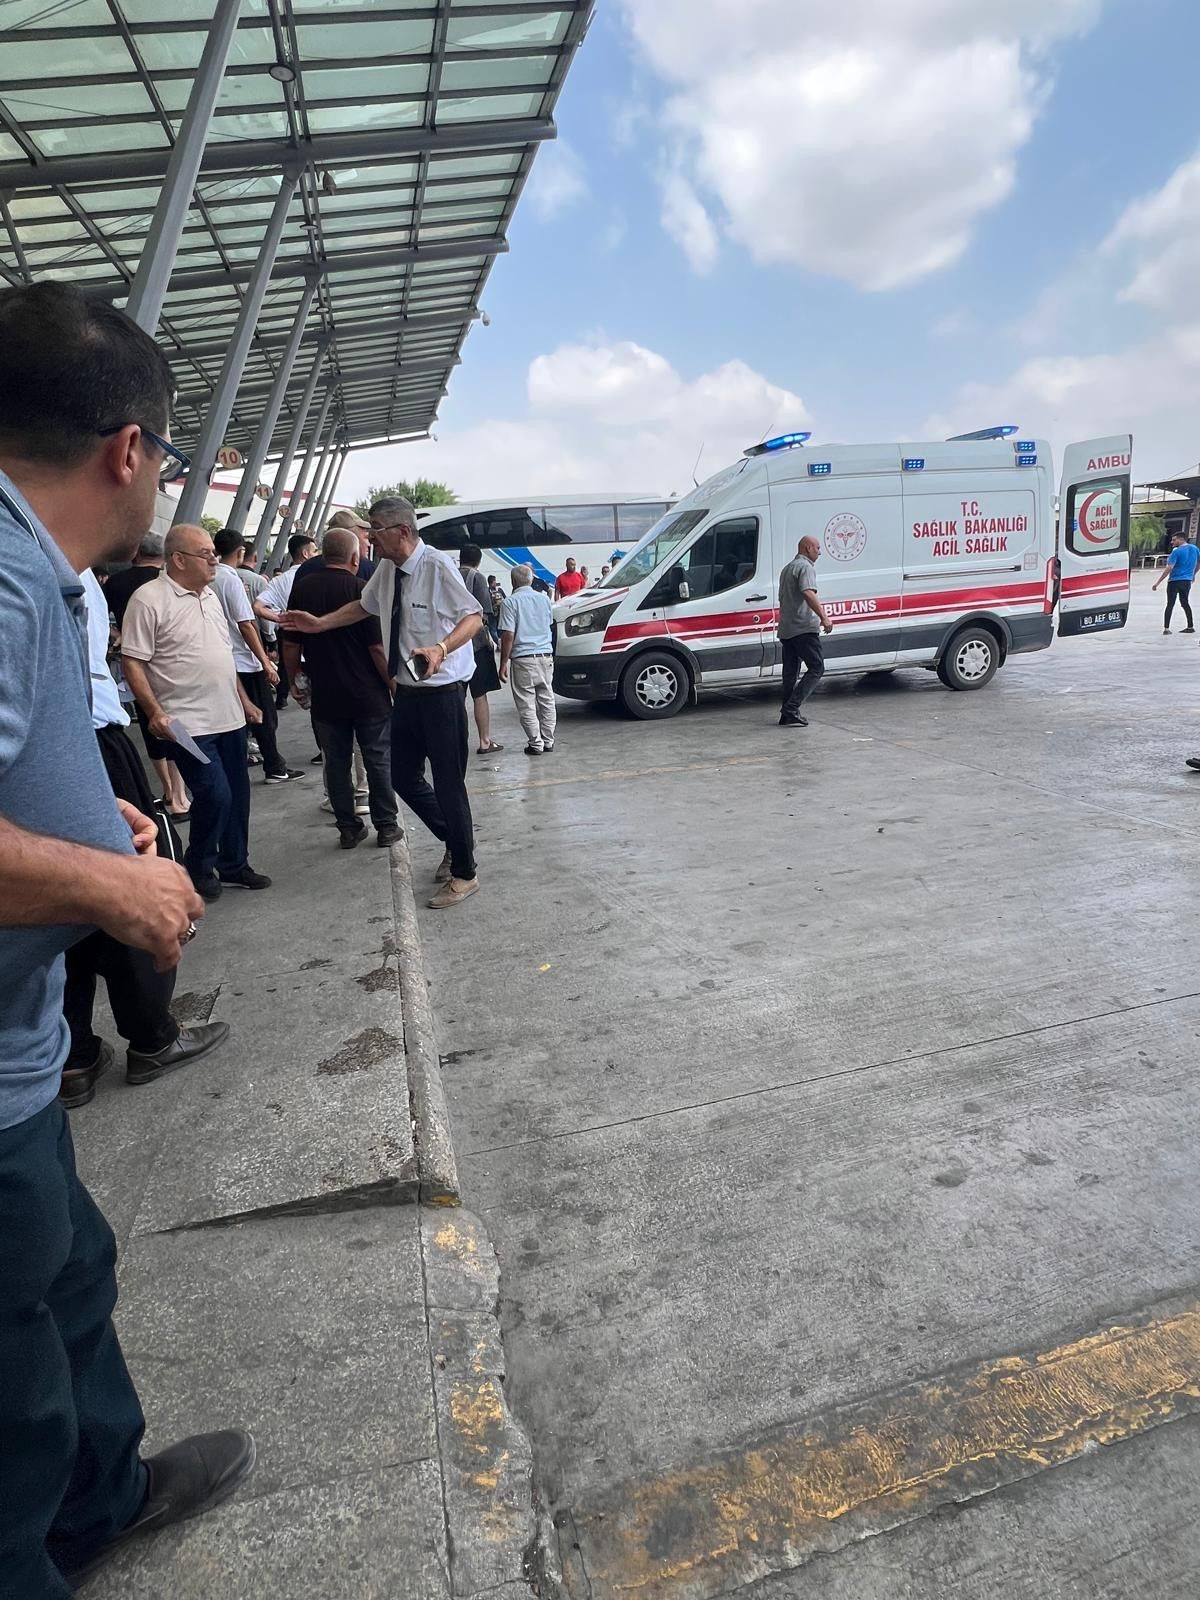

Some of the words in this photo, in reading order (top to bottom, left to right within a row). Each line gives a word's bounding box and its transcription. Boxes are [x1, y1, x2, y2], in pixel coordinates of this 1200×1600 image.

[220, 451, 238, 464] 10
[1087, 454, 1130, 470] AMBU
[257, 487, 269, 497] 11
[961, 501, 982, 516] T.C.
[1095, 504, 1113, 517] ACİL
[913, 519, 957, 538] SAĞLIK
[965, 515, 1028, 534] BAKANLIĞI
[1090, 518, 1118, 531] SAĞLIK
[933, 538, 960, 556] ACİL
[965, 536, 1008, 553] SAĞLIK
[821, 600, 877, 616] BULANS
